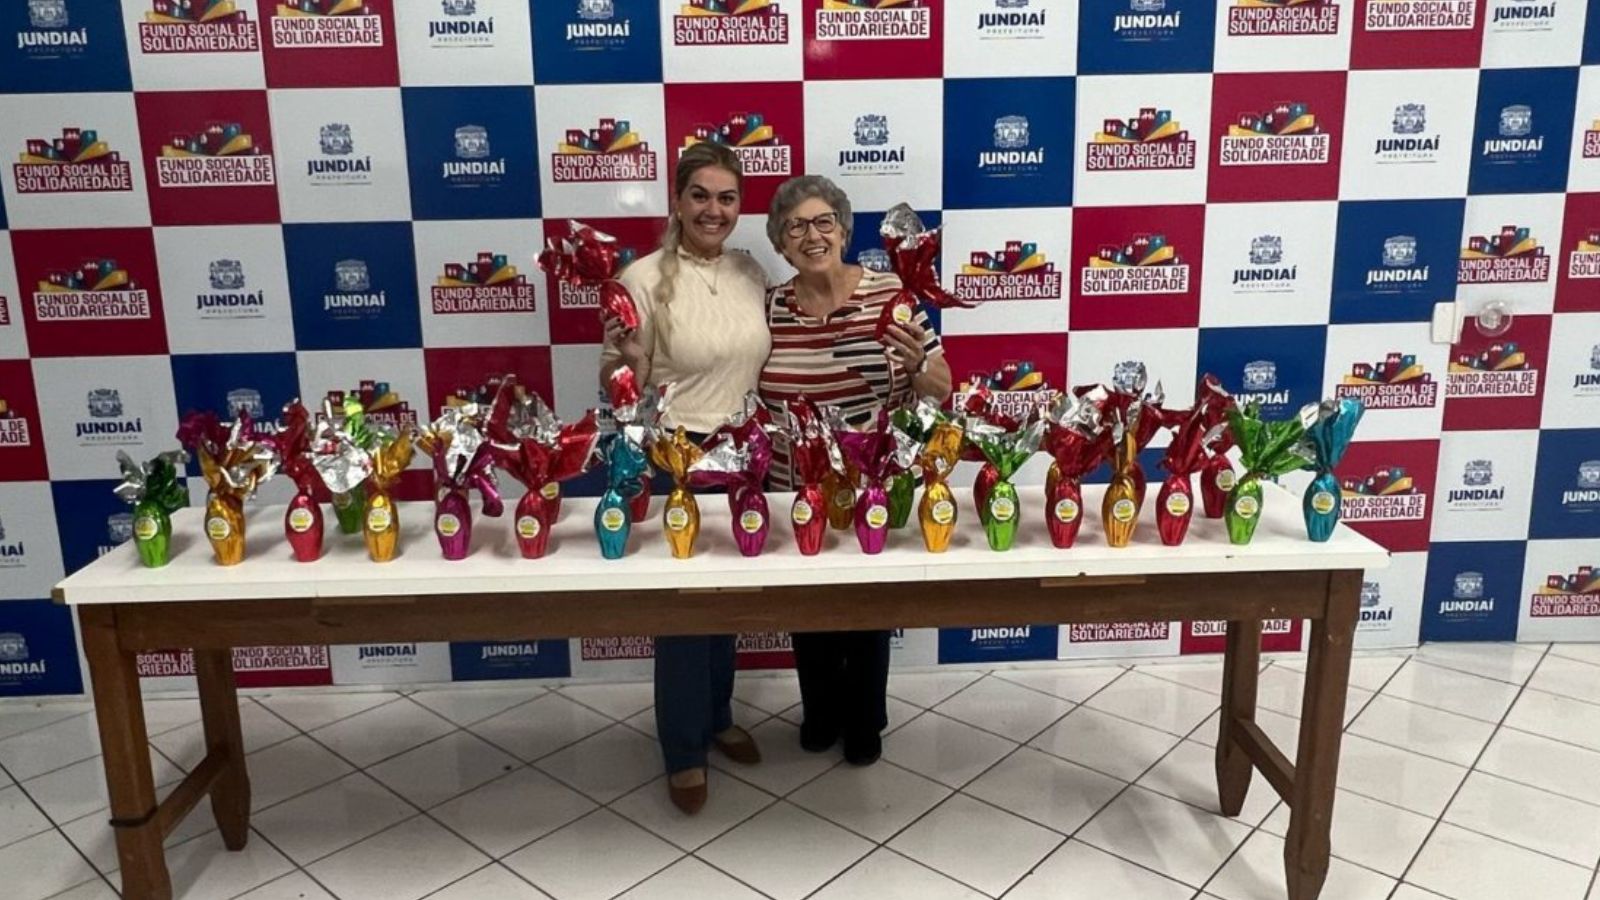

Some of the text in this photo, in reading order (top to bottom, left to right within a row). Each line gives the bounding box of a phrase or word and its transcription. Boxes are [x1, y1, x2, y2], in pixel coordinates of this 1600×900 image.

[1230, 6, 1337, 21] FUNDO SOCIAL DE
[1369, 1, 1472, 15] FUNDO SOCIAL DE
[1493, 2, 1556, 22] JUNDIAÍ
[274, 18, 380, 31] FUNDO SOCIAL DE
[676, 15, 786, 30] FUNDO SOCIAL DE
[818, 10, 926, 24] FUNDO SOCIAL DE
[978, 9, 1045, 29] JUNDIAÍ
[1114, 11, 1180, 31] JUNDIAÍ
[1367, 12, 1472, 27] SOLIDARIEDADE
[142, 22, 255, 37] FUNDO SOCIAL DE
[429, 17, 494, 37] JUNDIAÍ
[566, 19, 630, 40] JUNDIAÍ
[818, 22, 928, 37] SOLIDARIEDADE
[1229, 18, 1337, 34] SOLIDARIEDADE
[18, 27, 87, 48] JUNDIAÍ
[142, 34, 257, 50] SOLIDARIEDADE
[274, 29, 381, 44] SOLIDARIEDADE
[676, 27, 787, 43] SOLIDARIEDADE
[1089, 142, 1193, 156] FUNDO SOCIAL DE
[1224, 136, 1326, 150] FUNDO SOCIAL DE
[1375, 135, 1440, 154] JUNDIAÍ
[1483, 136, 1543, 155] JUNDIAÍ
[554, 153, 656, 168] FUNDO SOCIAL DE
[773, 148, 788, 159] DE
[839, 146, 904, 165] JUNDIAÍ
[978, 148, 1044, 167] JUNDIAÍ
[1222, 147, 1326, 162] SOLIDARIEDADE
[160, 156, 270, 172] FUNDO SOCIAL DE
[307, 157, 370, 175] JUNDIAÍ
[443, 158, 505, 178] JUNDIAÍ
[1088, 154, 1193, 169] SOLIDARIEDADE
[16, 163, 129, 178] FUNDO SOCIAL DE
[160, 170, 272, 184] SOLIDARIEDADE
[553, 166, 656, 181] SOLIDARIEDADE
[16, 177, 131, 192] SOLIDARIEDADE
[1460, 257, 1549, 270] UNDO SOCIAL DE
[957, 273, 1060, 287] FUNDO SOCIAL DE
[1084, 267, 1186, 280] FUNDO SOCIAL DE
[1233, 266, 1296, 284] JUNDIAÍ
[1366, 266, 1429, 285] JUNDIAÍ
[432, 285, 534, 299] FUNDO SOCIAL DE
[957, 284, 1061, 298] SOLIDARIEDADE
[1083, 278, 1186, 293] SOLIDARIEDADE
[37, 292, 145, 305] FUNDO SOCIAL DE
[197, 290, 264, 309] JUNDIAÍ
[324, 291, 385, 310] JUNDIAÍ
[433, 297, 535, 313] SOLIDARIEDADE
[39, 303, 148, 318] SOLIDARIEDADE
[1482, 373, 1519, 383] SOCIAL
[1522, 372, 1535, 382] DE
[1337, 383, 1435, 396] FUNDO SOCIAL DE
[76, 418, 142, 437] JUNDIAÍ
[1448, 486, 1505, 502] JUNDIAÍ
[1342, 496, 1423, 508] NDO SOCIAL DE
[1438, 598, 1494, 614] JUNDIAÍ
[1533, 596, 1568, 605] FUNDO
[1361, 606, 1393, 621] DIAÍ
[971, 625, 1030, 642] JUNDIAÍ
[1071, 627, 1167, 641] SOLIDARIEDADE
[359, 643, 417, 659] JUNDIAÍ
[482, 643, 538, 659] JUNDIAÍ
[234, 656, 326, 669] OLIDARIEDADE
